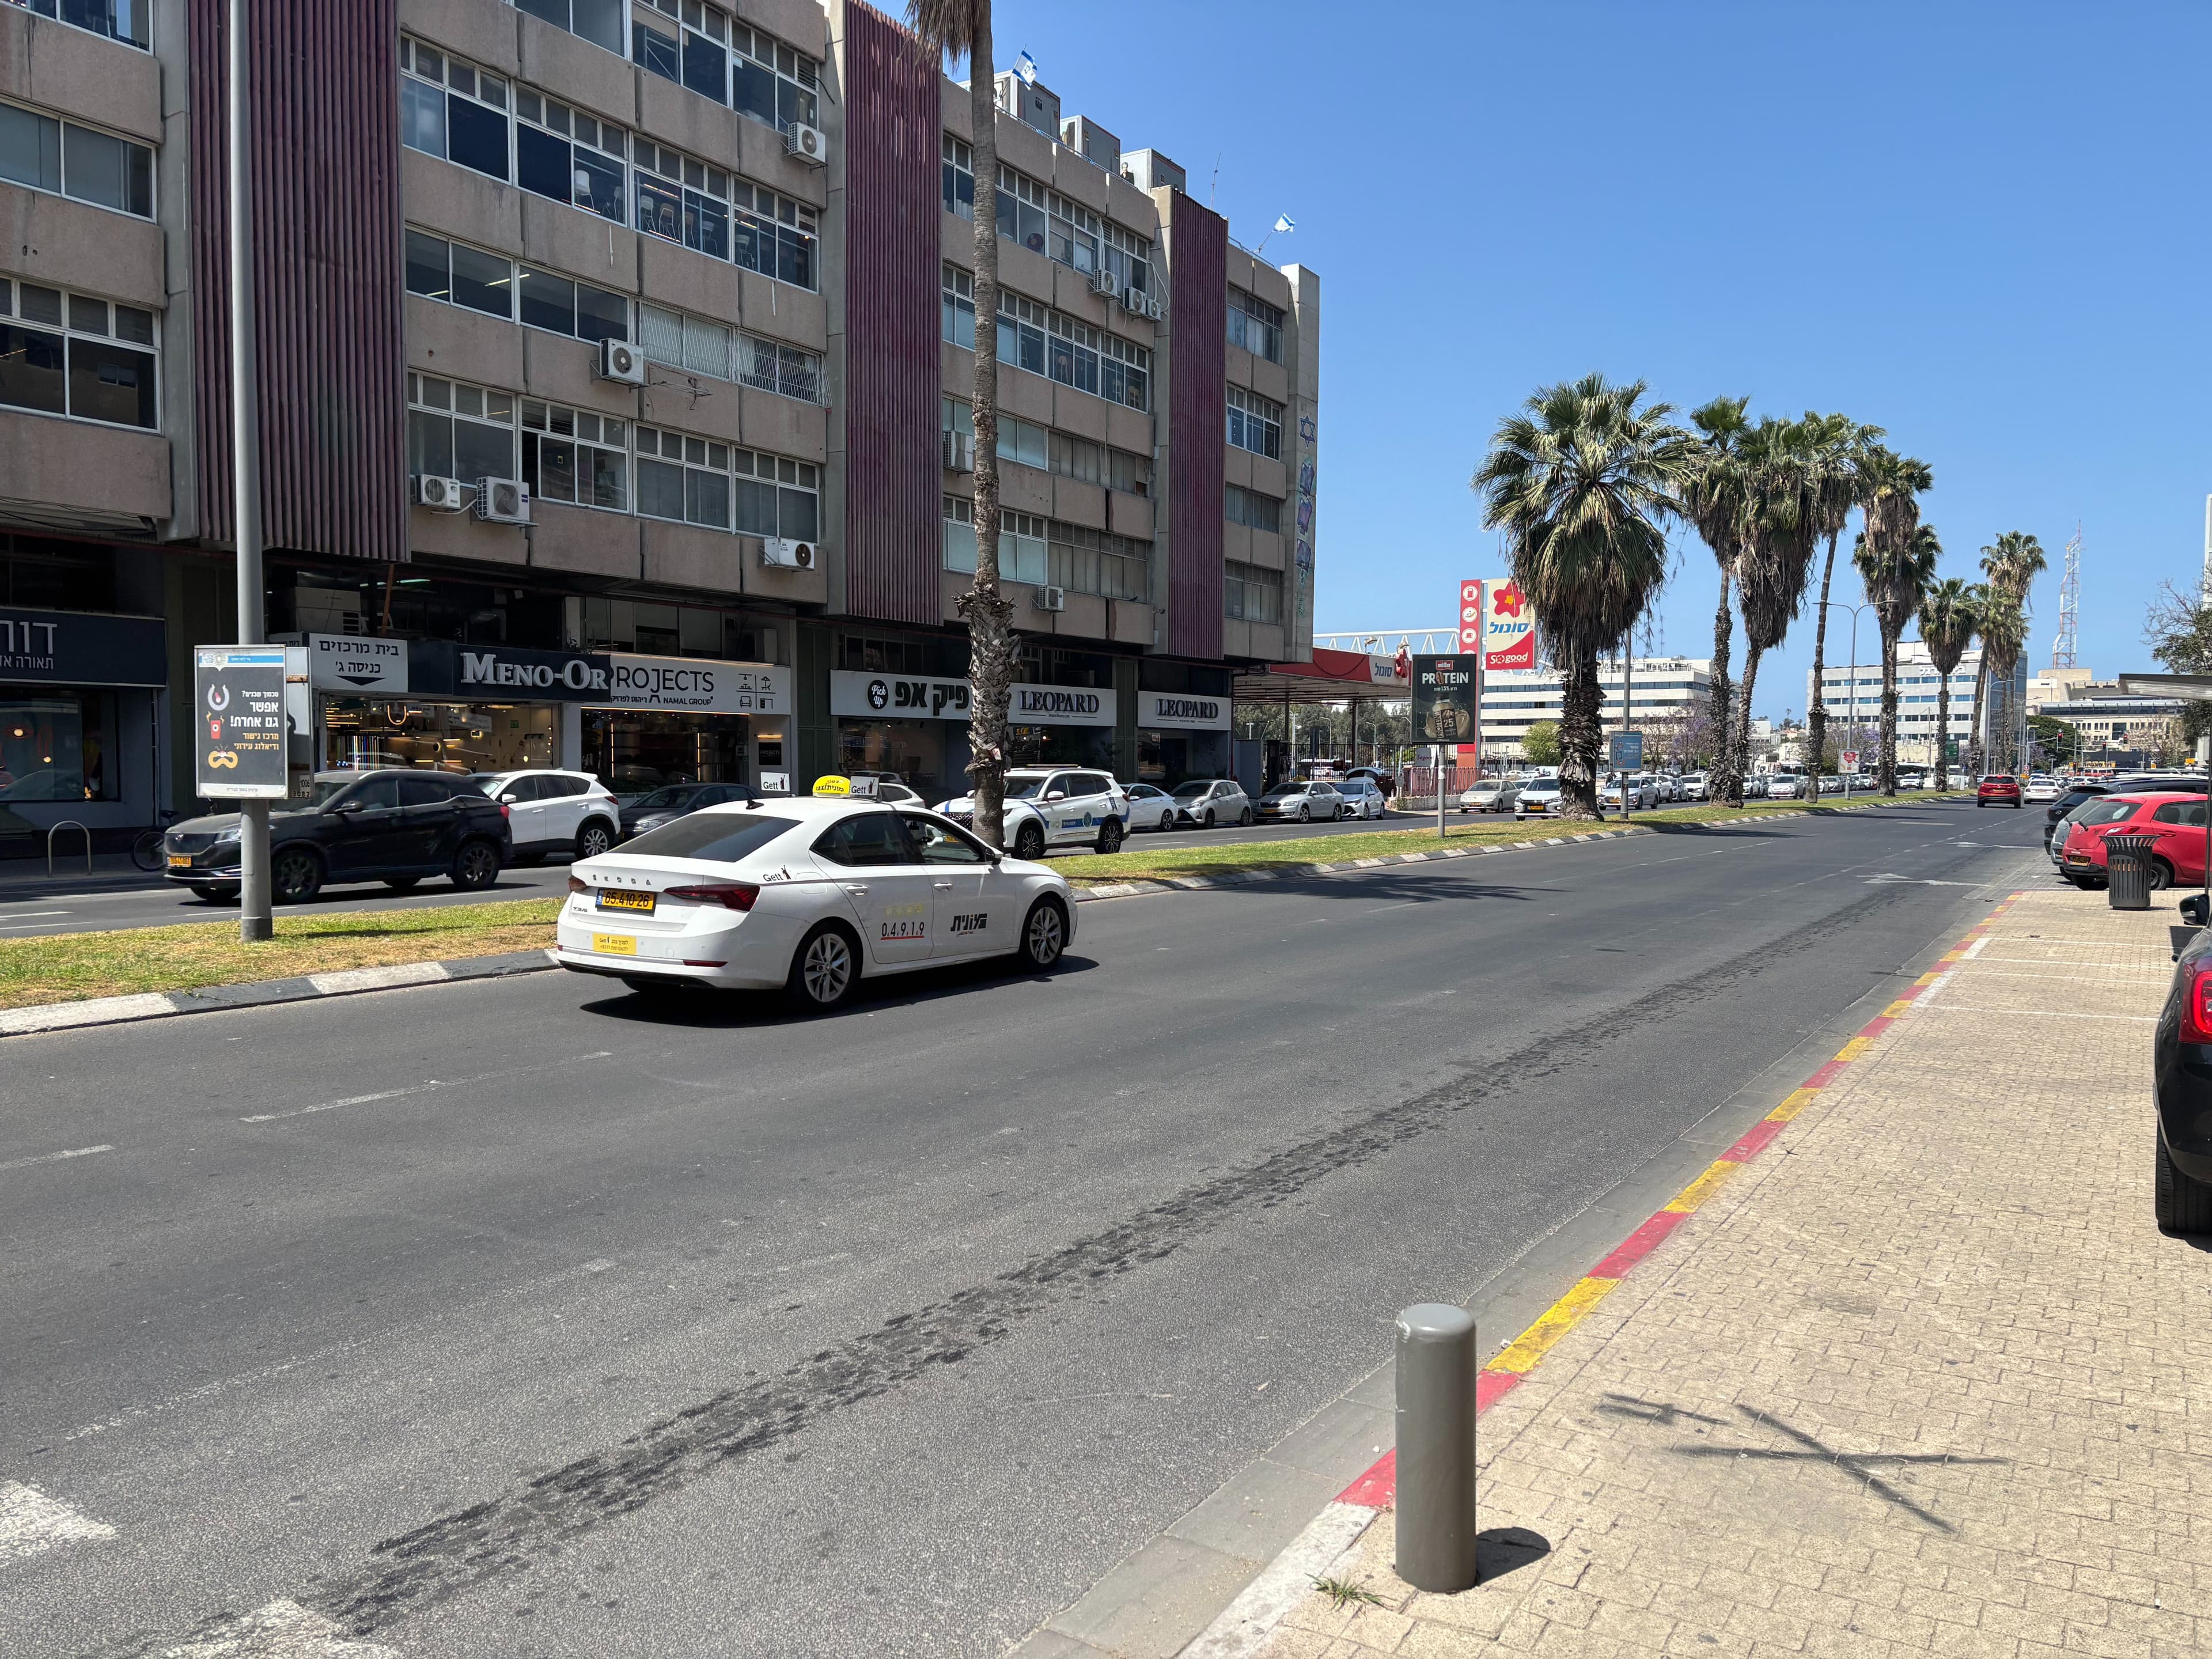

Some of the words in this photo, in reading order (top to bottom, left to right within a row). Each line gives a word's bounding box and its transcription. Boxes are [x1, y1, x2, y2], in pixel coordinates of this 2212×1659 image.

[1489, 622, 1529, 634] סונול
[319, 640, 369, 653] מרכזים
[376, 644, 399, 656] בית
[16, 656, 53, 669] תאורה
[348, 662, 381, 673] כניסה
[1374, 662, 1392, 677] סונול
[611, 666, 714, 694] ROJECTS
[871, 684, 887, 695] Pick
[895, 681, 927, 707] אפ
[873, 696, 884, 707] Up
[933, 684, 969, 716] פיק
[1020, 691, 1100, 713] LEOPARD
[249, 702, 279, 712] אפשר
[1157, 699, 1219, 718] LEOPARD
[230, 715, 262, 727] אחרת!
[265, 717, 279, 727] גם
[1443, 718, 1453, 728] 25
[763, 781, 778, 790] Gett
[851, 786, 866, 794] Gett
[763, 873, 784, 881] Gett
